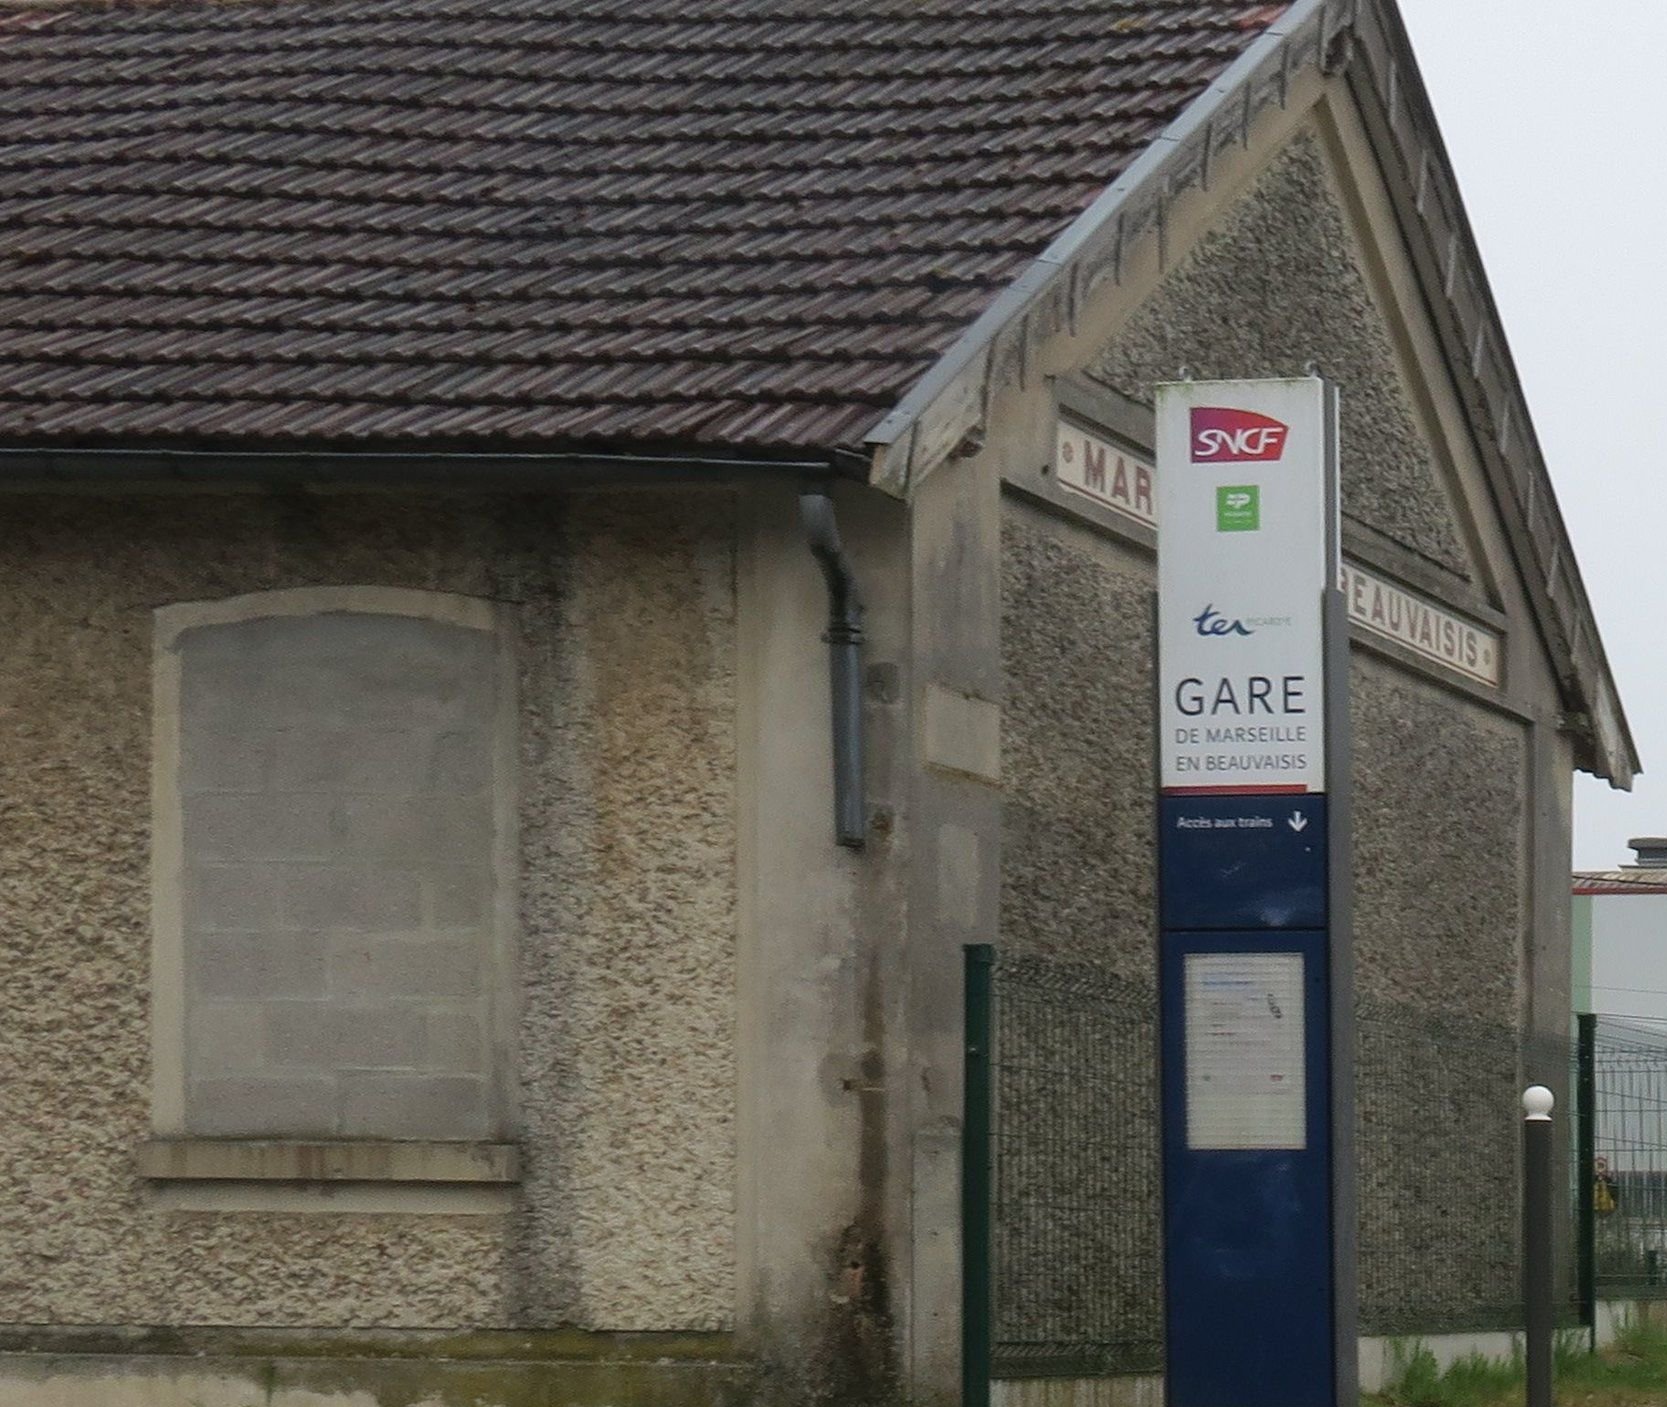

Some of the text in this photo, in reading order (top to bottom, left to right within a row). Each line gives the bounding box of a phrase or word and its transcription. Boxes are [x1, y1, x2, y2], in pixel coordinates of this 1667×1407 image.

[1194, 427, 1284, 456] SNCF
[1084, 440, 1153, 516] MAR
[1175, 676, 1306, 717] GARE
[1175, 726, 1307, 744] DE MARSEILLE
[1176, 754, 1307, 772] EN BEAUVAISIS
[1176, 816, 1274, 829] Accès aux trains
